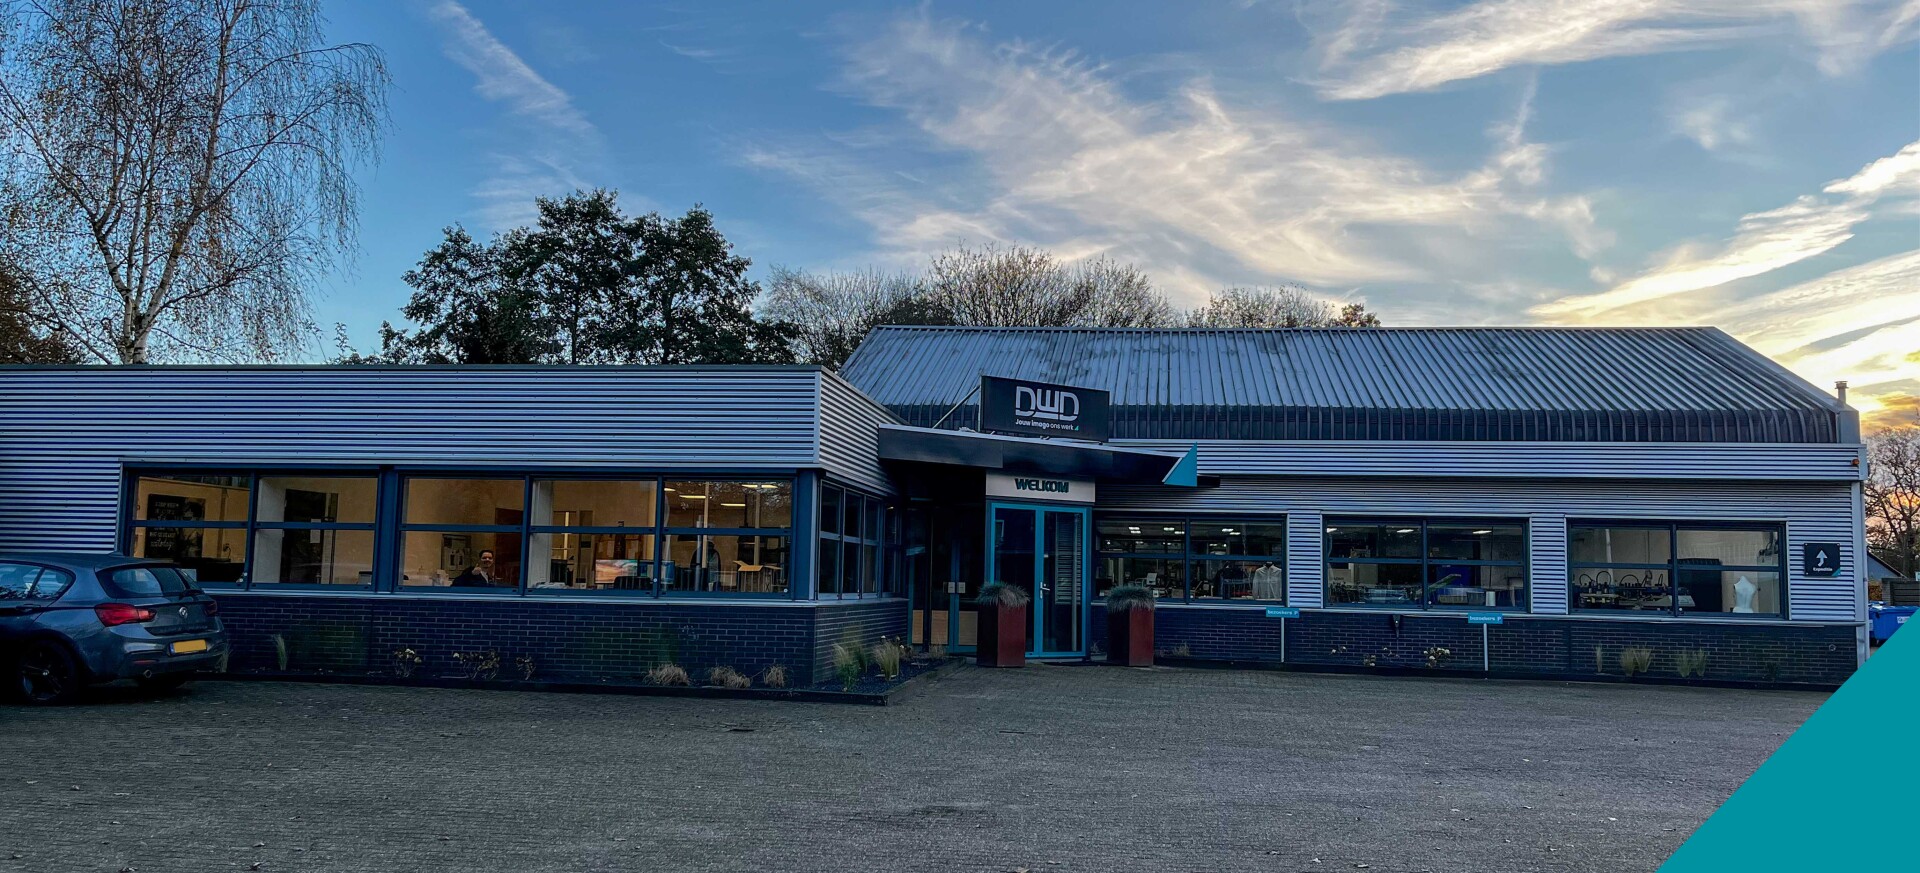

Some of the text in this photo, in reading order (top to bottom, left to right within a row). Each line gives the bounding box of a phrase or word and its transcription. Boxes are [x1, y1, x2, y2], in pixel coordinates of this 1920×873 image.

[1015, 386, 1080, 421] DWD
[1015, 418, 1031, 426] Jouw
[1031, 419, 1050, 429] imago
[1014, 478, 1069, 493] WELKOM
